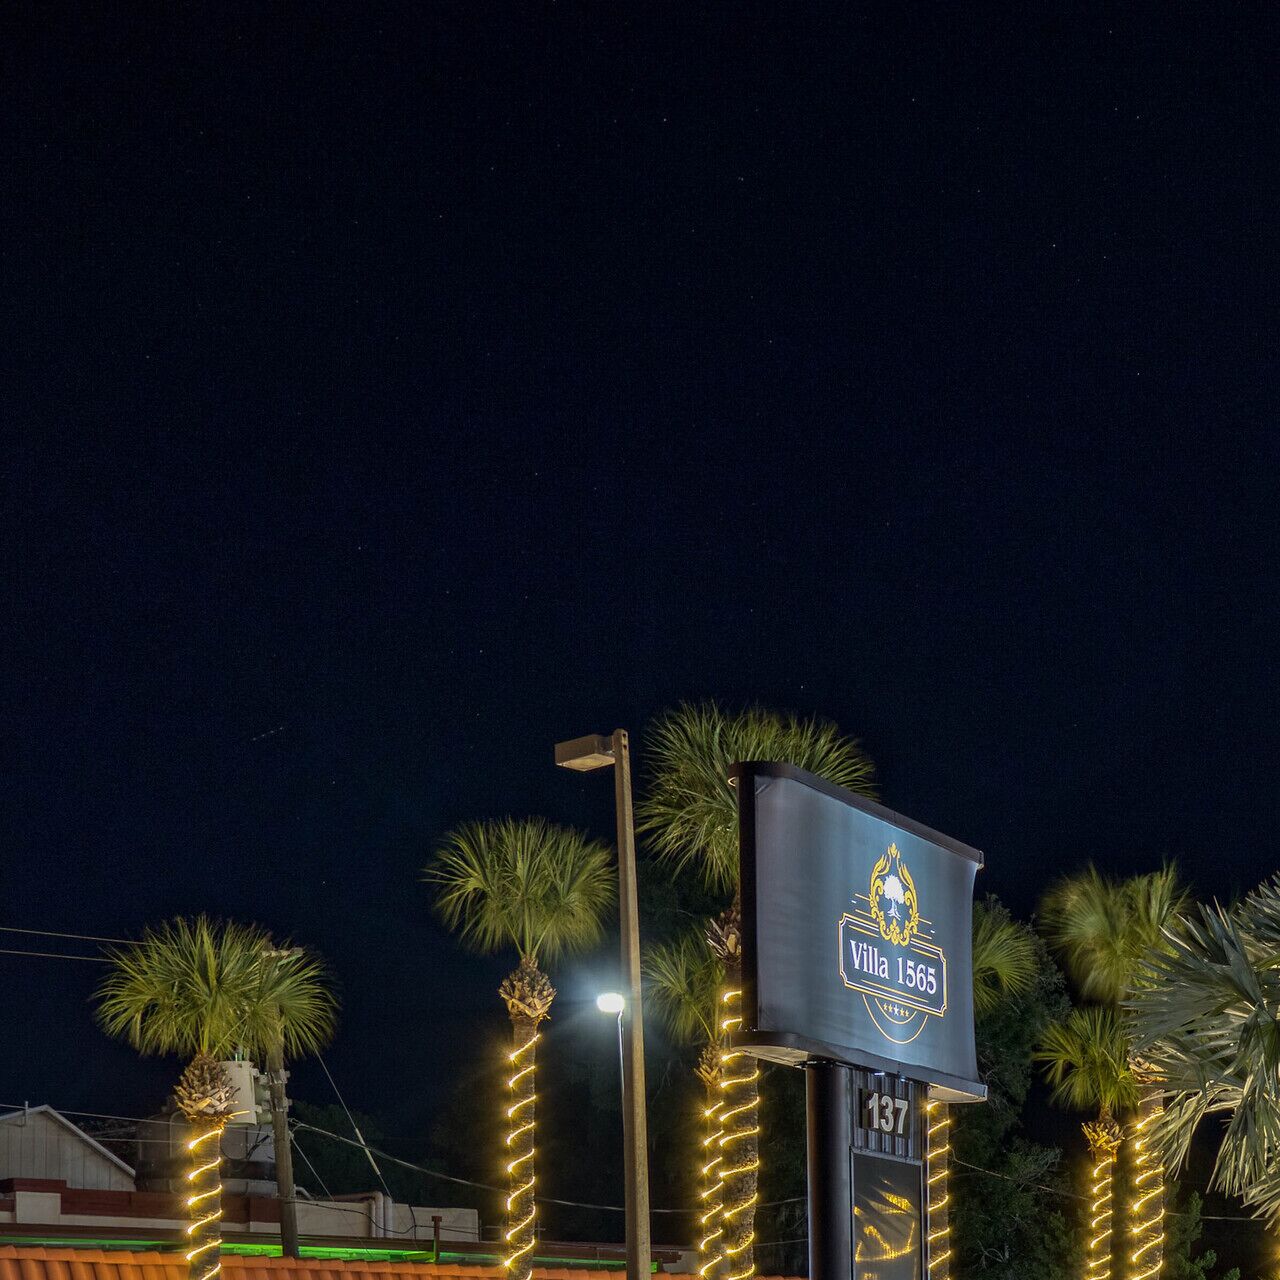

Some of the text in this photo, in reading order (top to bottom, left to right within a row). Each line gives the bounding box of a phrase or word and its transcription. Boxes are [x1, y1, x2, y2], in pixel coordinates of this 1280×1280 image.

[850, 940, 937, 995] Villa 1565
[869, 1092, 908, 1134] 137
